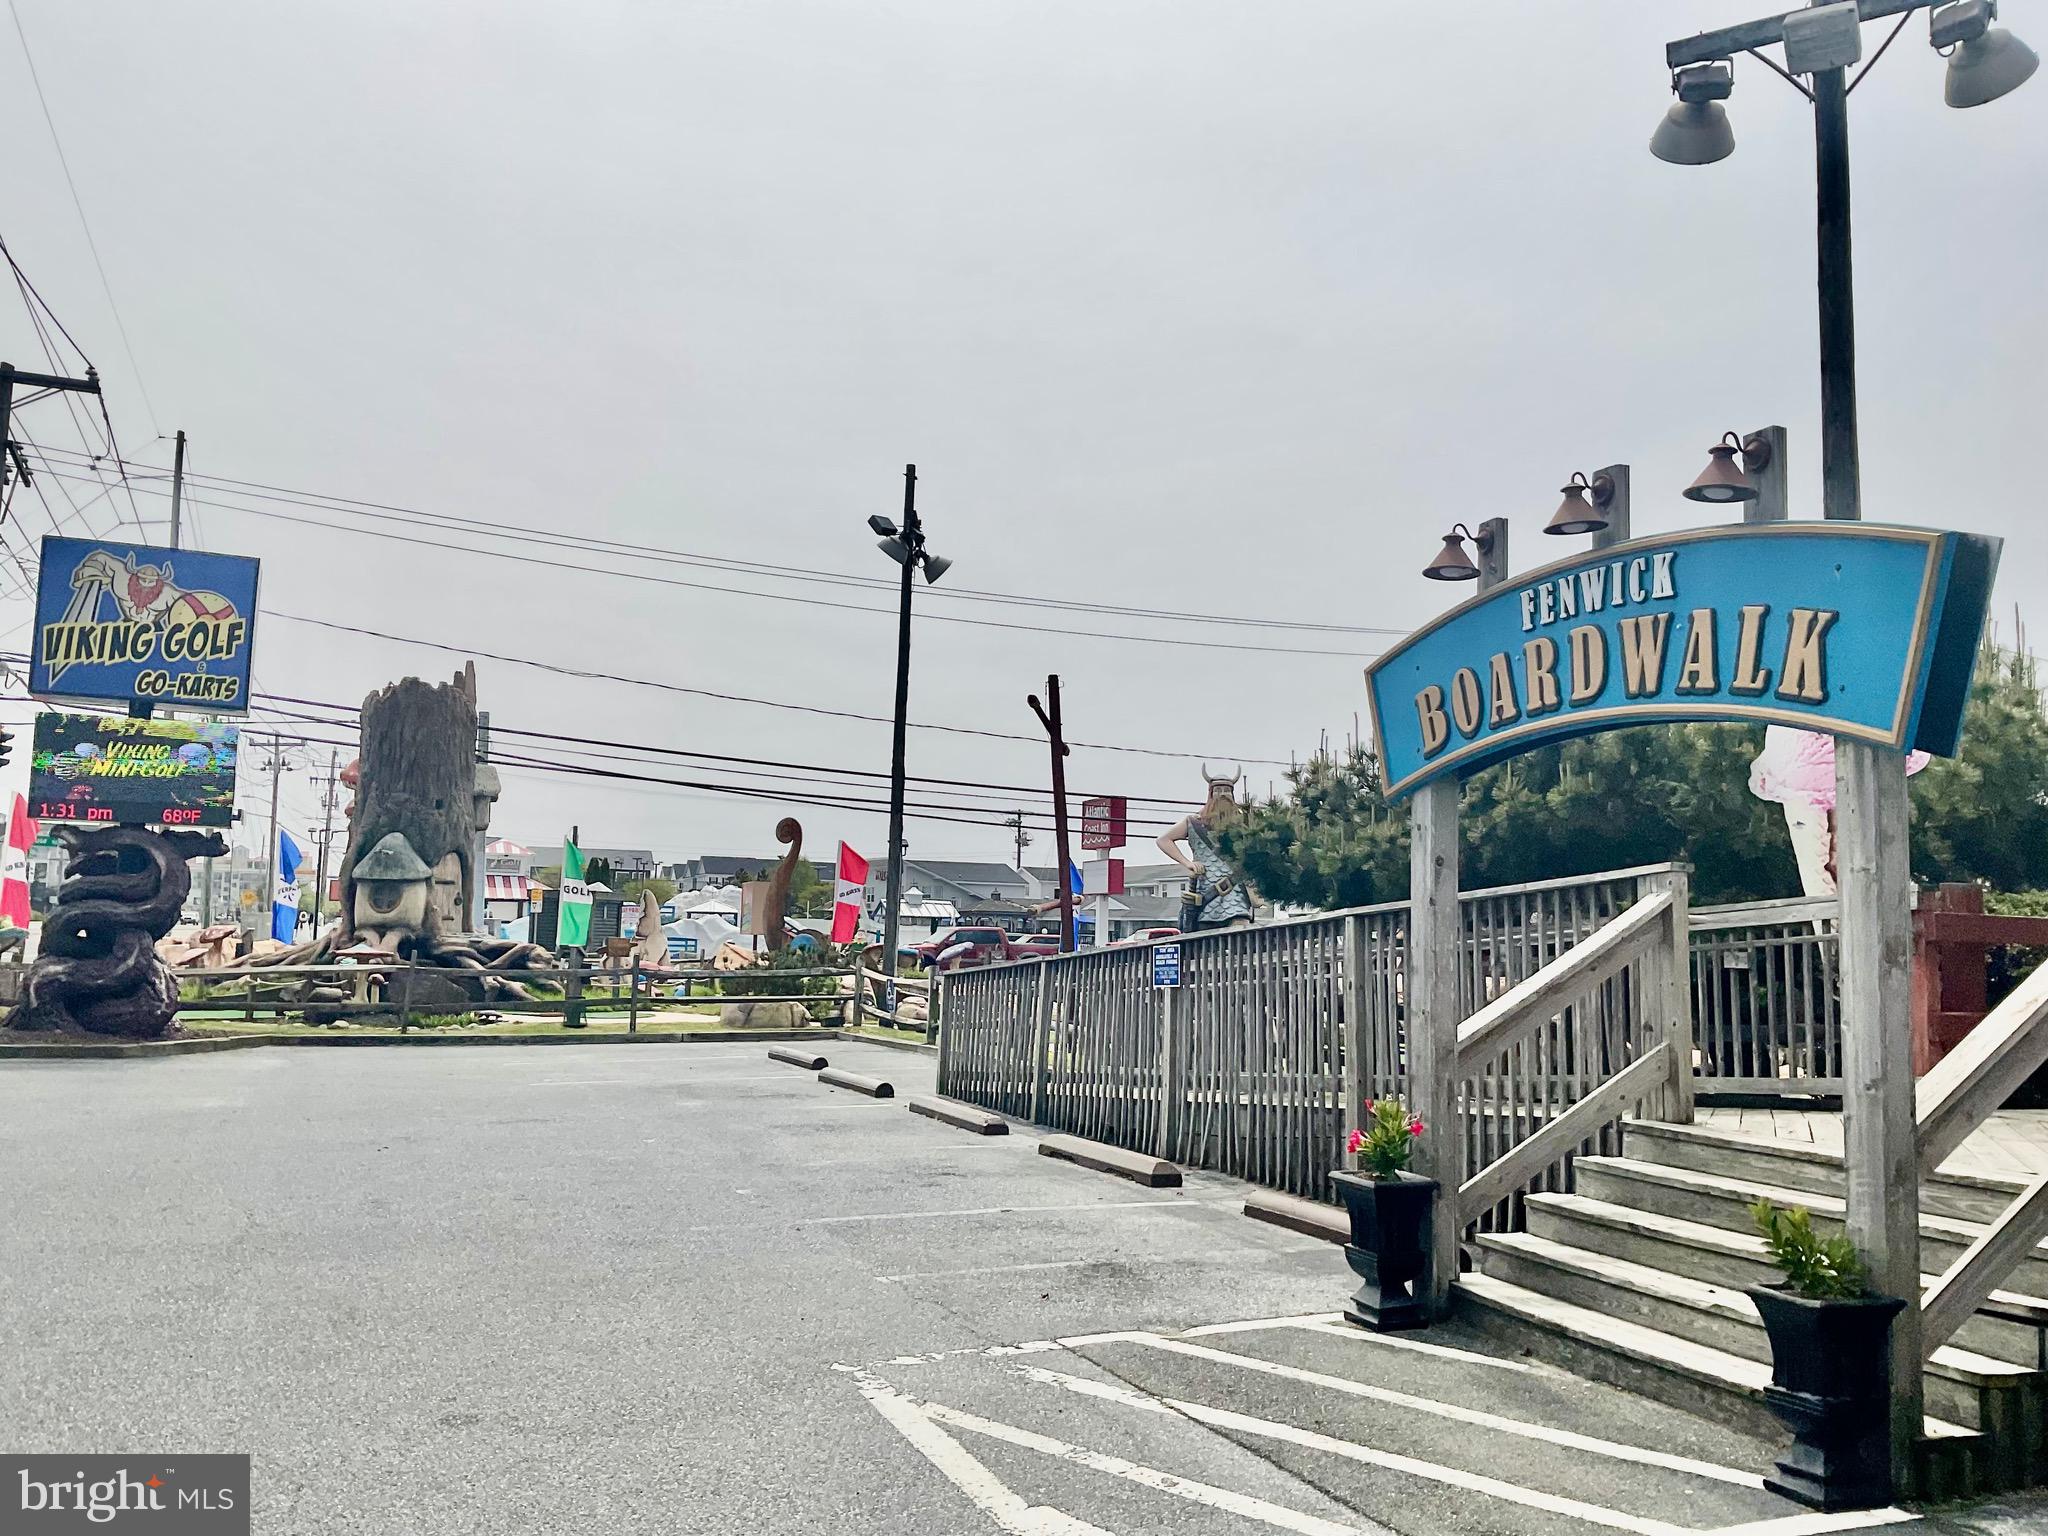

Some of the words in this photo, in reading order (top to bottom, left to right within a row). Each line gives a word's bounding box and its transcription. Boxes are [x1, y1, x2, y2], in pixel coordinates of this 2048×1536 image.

[1519, 552, 1675, 632] FENWICK
[43, 621, 155, 665] VIKING
[162, 617, 246, 662] GOLF
[134, 669, 240, 701] GO-KARTS
[1415, 603, 1839, 759] BOARDWALK
[40, 803, 76, 818] 1:31
[87, 807, 113, 821] pm
